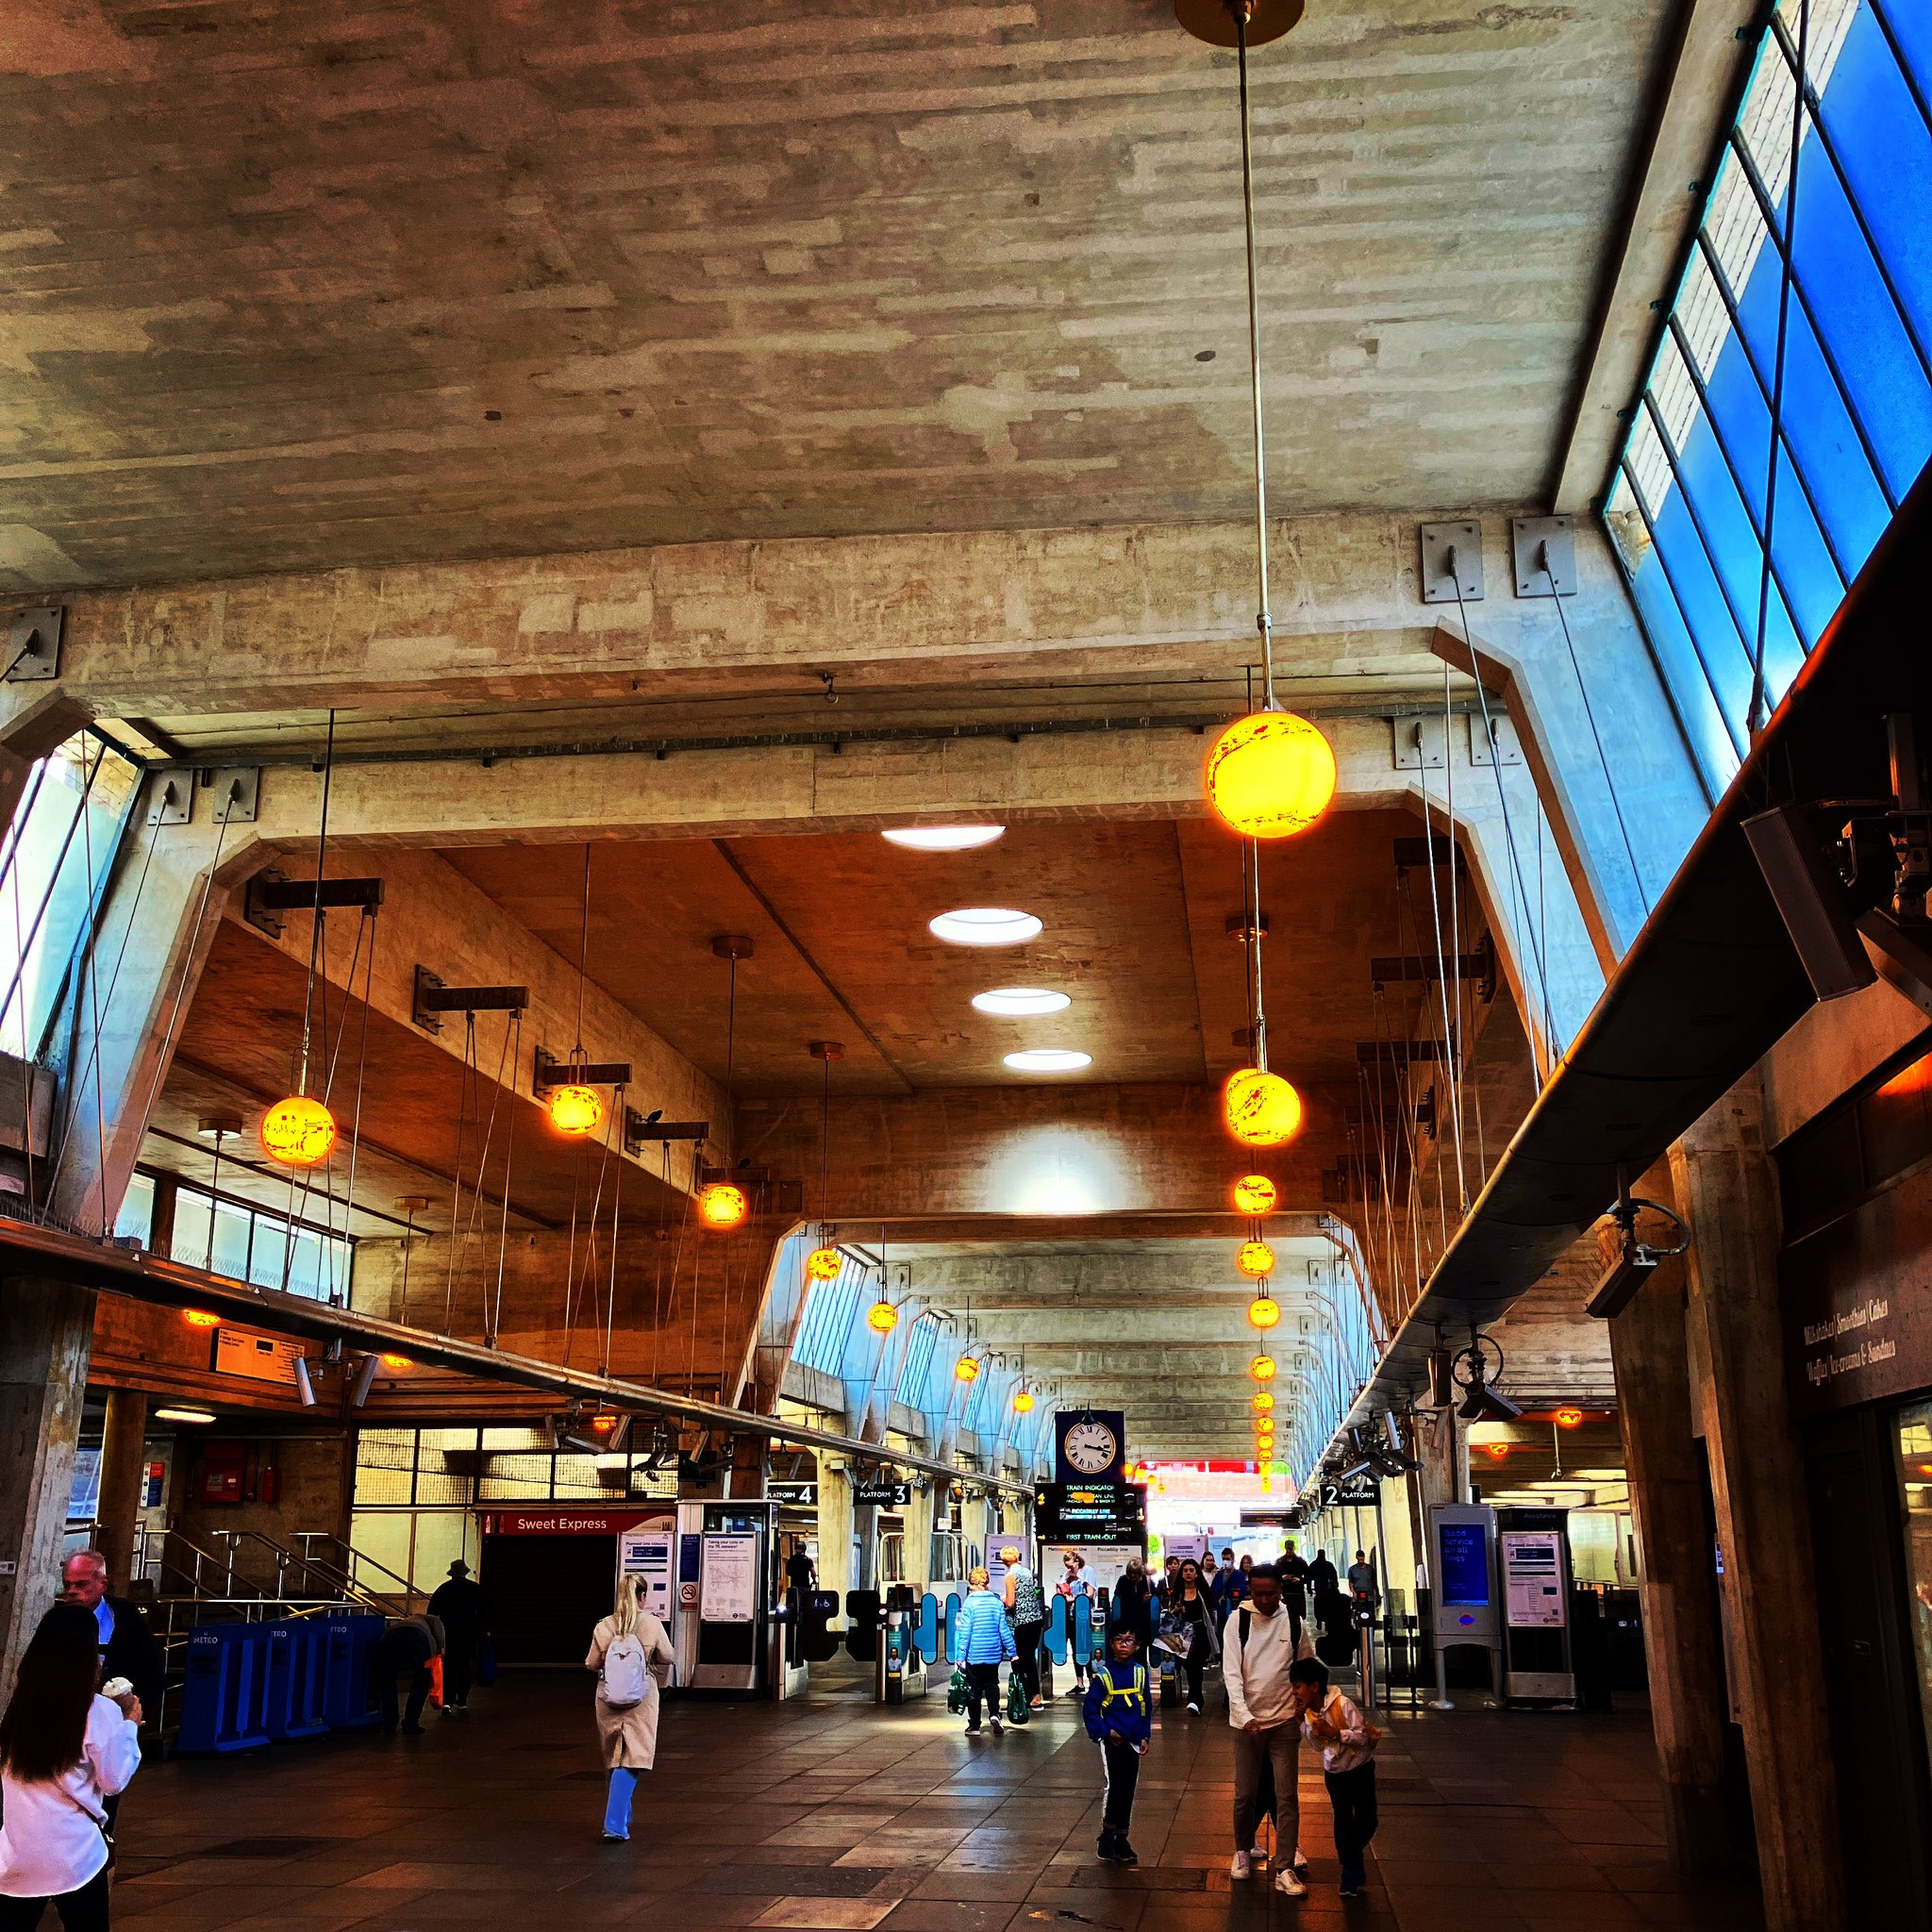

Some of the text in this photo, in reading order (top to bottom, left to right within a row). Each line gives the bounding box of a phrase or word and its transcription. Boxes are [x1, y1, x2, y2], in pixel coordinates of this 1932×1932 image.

[1869, 1298, 1889, 1323] Cakes
[798, 1486, 811, 1504] 4
[894, 1485, 906, 1504] 3
[1325, 1485, 1338, 1505] 2
[518, 1519, 608, 1531] Sweet Express
